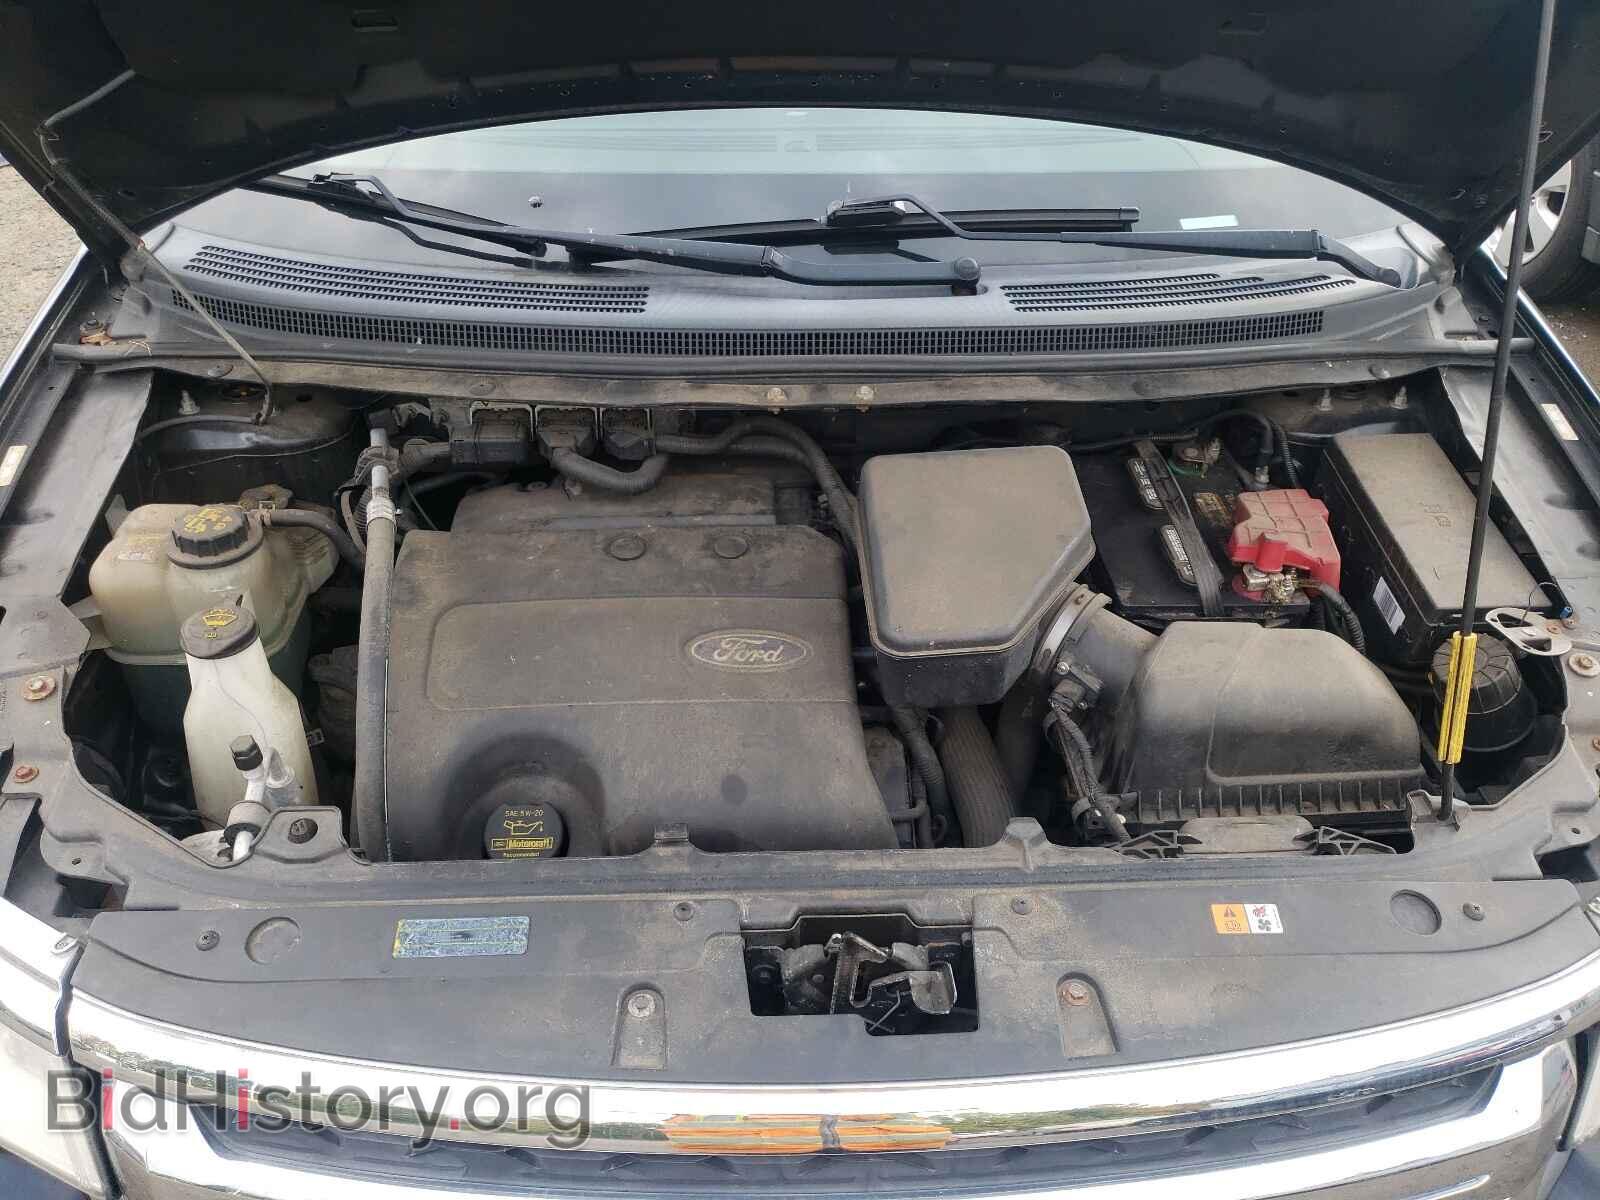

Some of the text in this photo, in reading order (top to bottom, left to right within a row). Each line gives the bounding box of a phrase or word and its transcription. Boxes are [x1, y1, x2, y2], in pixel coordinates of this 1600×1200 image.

[714, 638, 784, 662] Ford
[520, 809, 544, 817] 5W-20
[509, 838, 551, 849] Motorcraft
